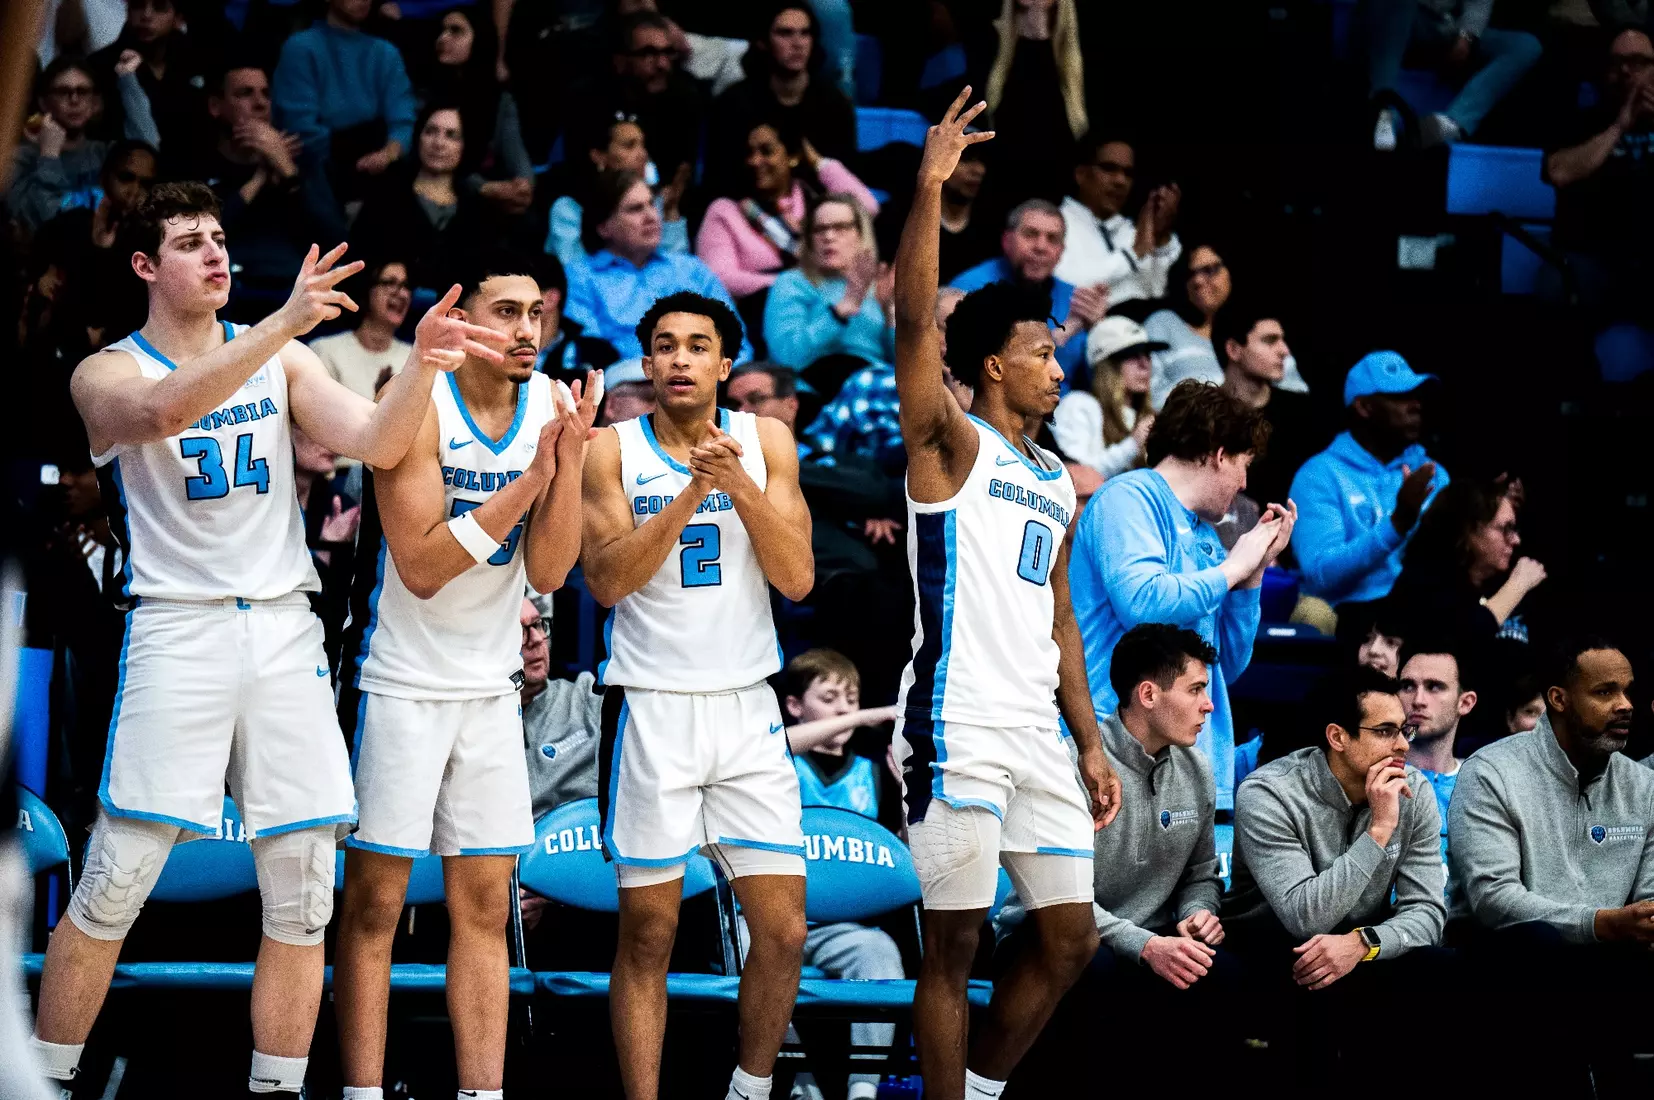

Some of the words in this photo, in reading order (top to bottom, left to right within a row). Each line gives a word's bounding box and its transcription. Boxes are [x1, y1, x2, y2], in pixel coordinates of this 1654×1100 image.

[179, 433, 270, 500] 34
[680, 523, 722, 588] 2
[1016, 519, 1053, 587] 0
[803, 834, 896, 869] UMBIA
